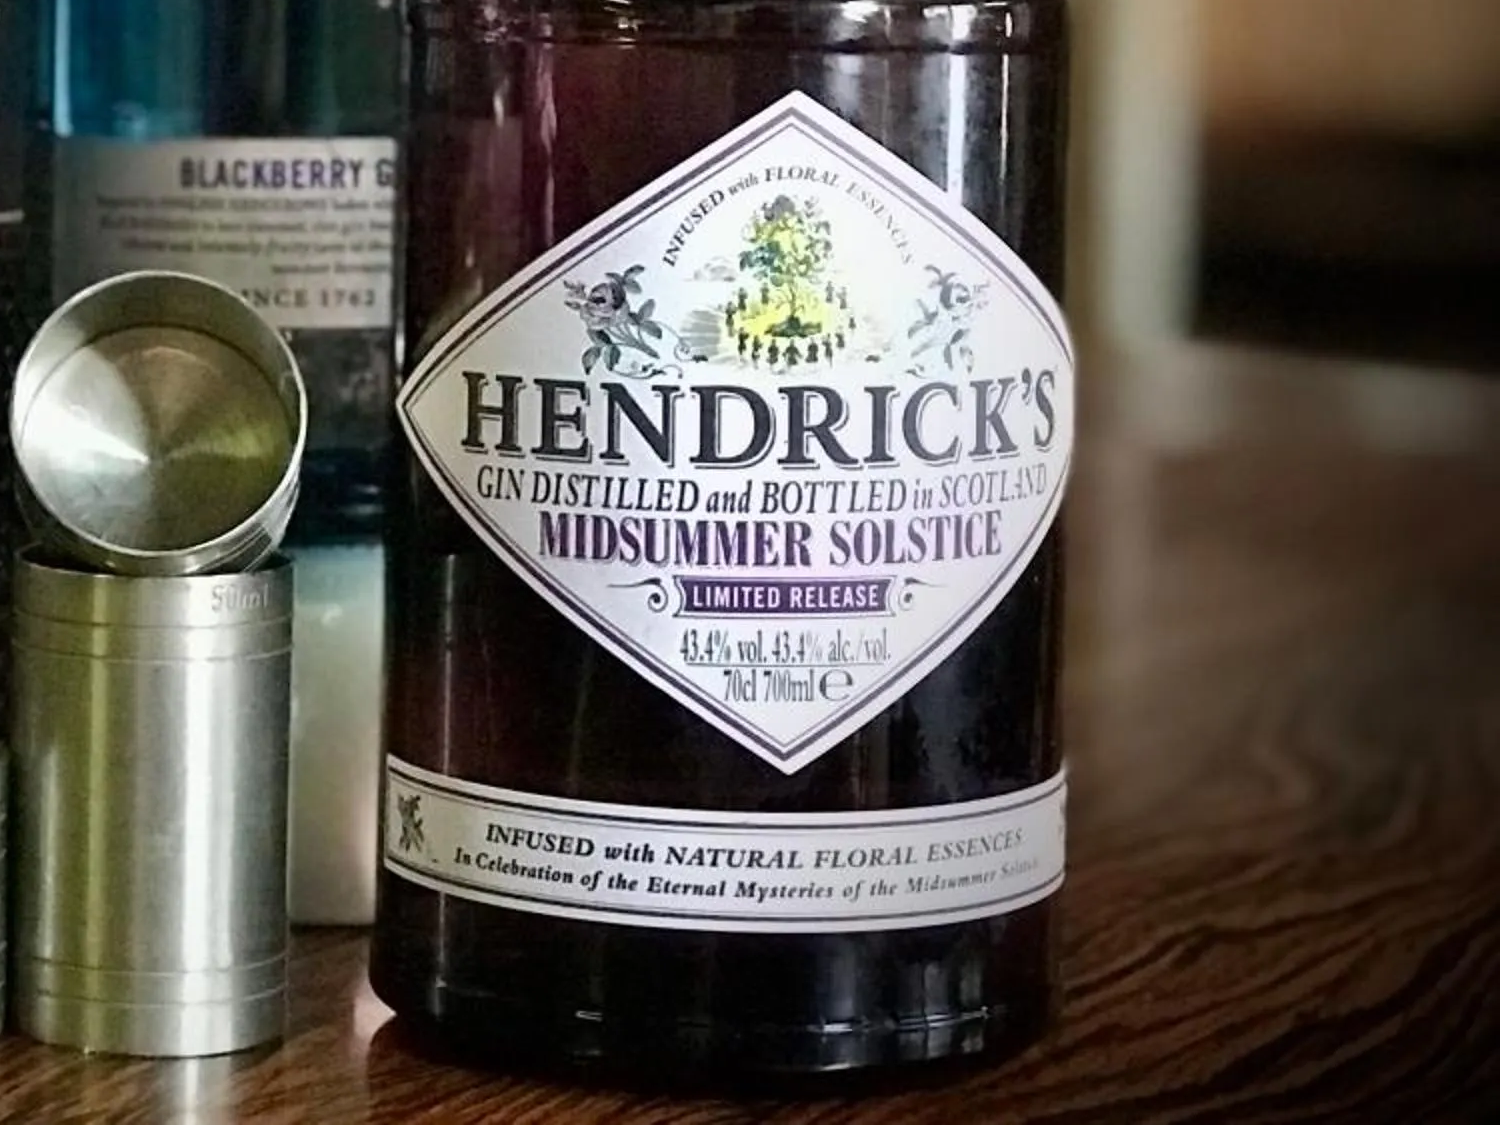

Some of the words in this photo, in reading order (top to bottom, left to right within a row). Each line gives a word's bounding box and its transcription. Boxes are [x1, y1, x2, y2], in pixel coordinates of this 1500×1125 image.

[180, 157, 363, 190] BLACKBERRY
[662, 190, 726, 268] INFUSED
[728, 172, 760, 197] with
[764, 165, 840, 188] FLORAL
[460, 366, 1058, 471] HENDRICK'S
[476, 464, 524, 504] GIN
[530, 472, 700, 514] DISTILLED
[705, 480, 754, 515] and
[760, 477, 907, 516] BOTTLED
[912, 478, 934, 512] in
[938, 462, 1048, 509] SCOTLAND
[537, 510, 812, 569] MIDSUMMER
[828, 509, 1003, 567] SOLSTICE
[693, 586, 780, 609] LIMITED
[789, 586, 880, 609] RELEASE
[679, 628, 732, 663] 43.4%
[737, 629, 768, 663] vol.
[771, 630, 823, 664] 43.4%
[723, 669, 757, 702] 70cl
[762, 669, 814, 702] 700ml
[485, 822, 596, 858] INFUSED
[603, 842, 655, 863] with
[666, 845, 804, 870] NATURAL
[813, 847, 918, 870] FLORAL
[926, 827, 1023, 863] ESSENCES
[454, 846, 472, 866] In
[475, 850, 574, 884] Celebration
[580, 869, 603, 891] of
[607, 872, 638, 893] the
[646, 875, 726, 897] Eternal
[733, 880, 834, 904] Mysteries
[841, 881, 864, 902] of
[868, 878, 898, 898] the
[904, 869, 997, 894] Midsummer
